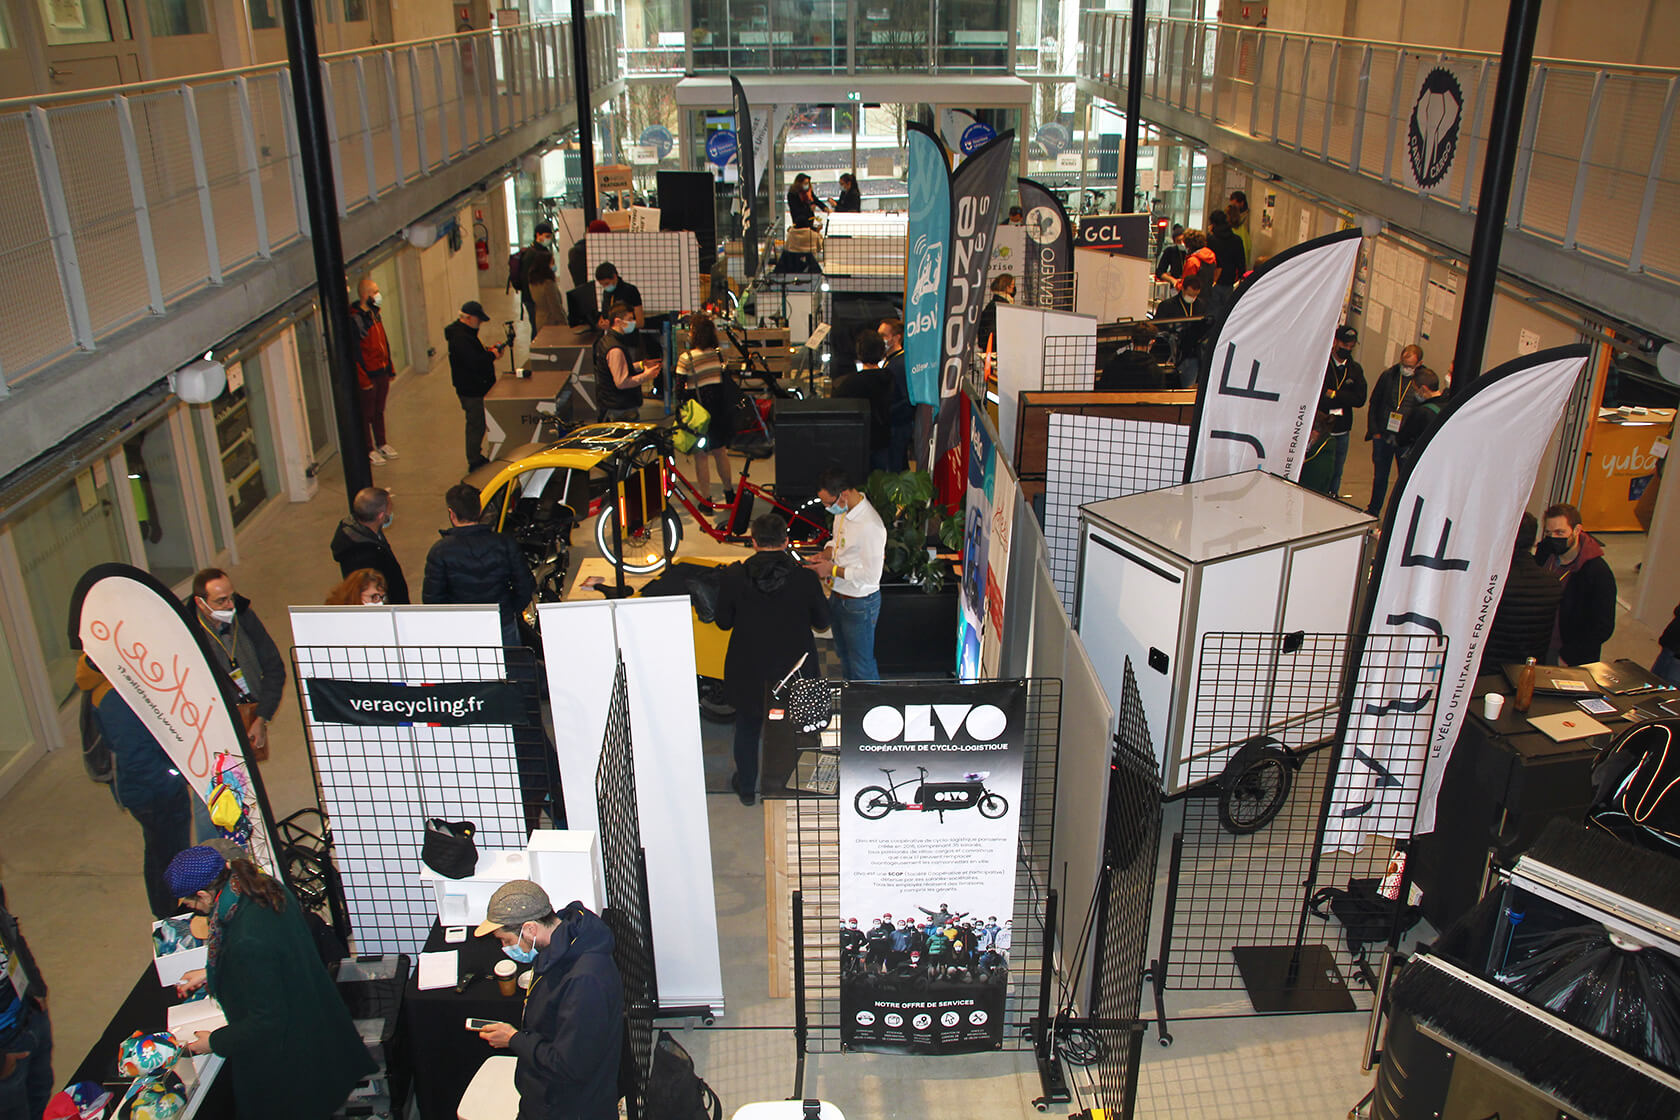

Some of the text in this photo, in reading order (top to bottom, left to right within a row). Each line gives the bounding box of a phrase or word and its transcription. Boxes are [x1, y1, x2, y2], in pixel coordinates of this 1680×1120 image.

[1430, 141, 1451, 179] CARGO
[1085, 225, 1121, 242] GCL
[1288, 404, 1307, 453] FRANÇAIS
[1601, 446, 1657, 478] yuba
[1432, 573, 1498, 759] LE VÉLO UTILITAIRE FRANÇAIS
[349, 695, 484, 720] veracycling.fr
[859, 744, 916, 752] COOPÉRATIVE
[930, 743, 1009, 752] CYCLO-LOGISTIQUE
[938, 999, 974, 1007] SERVICES
